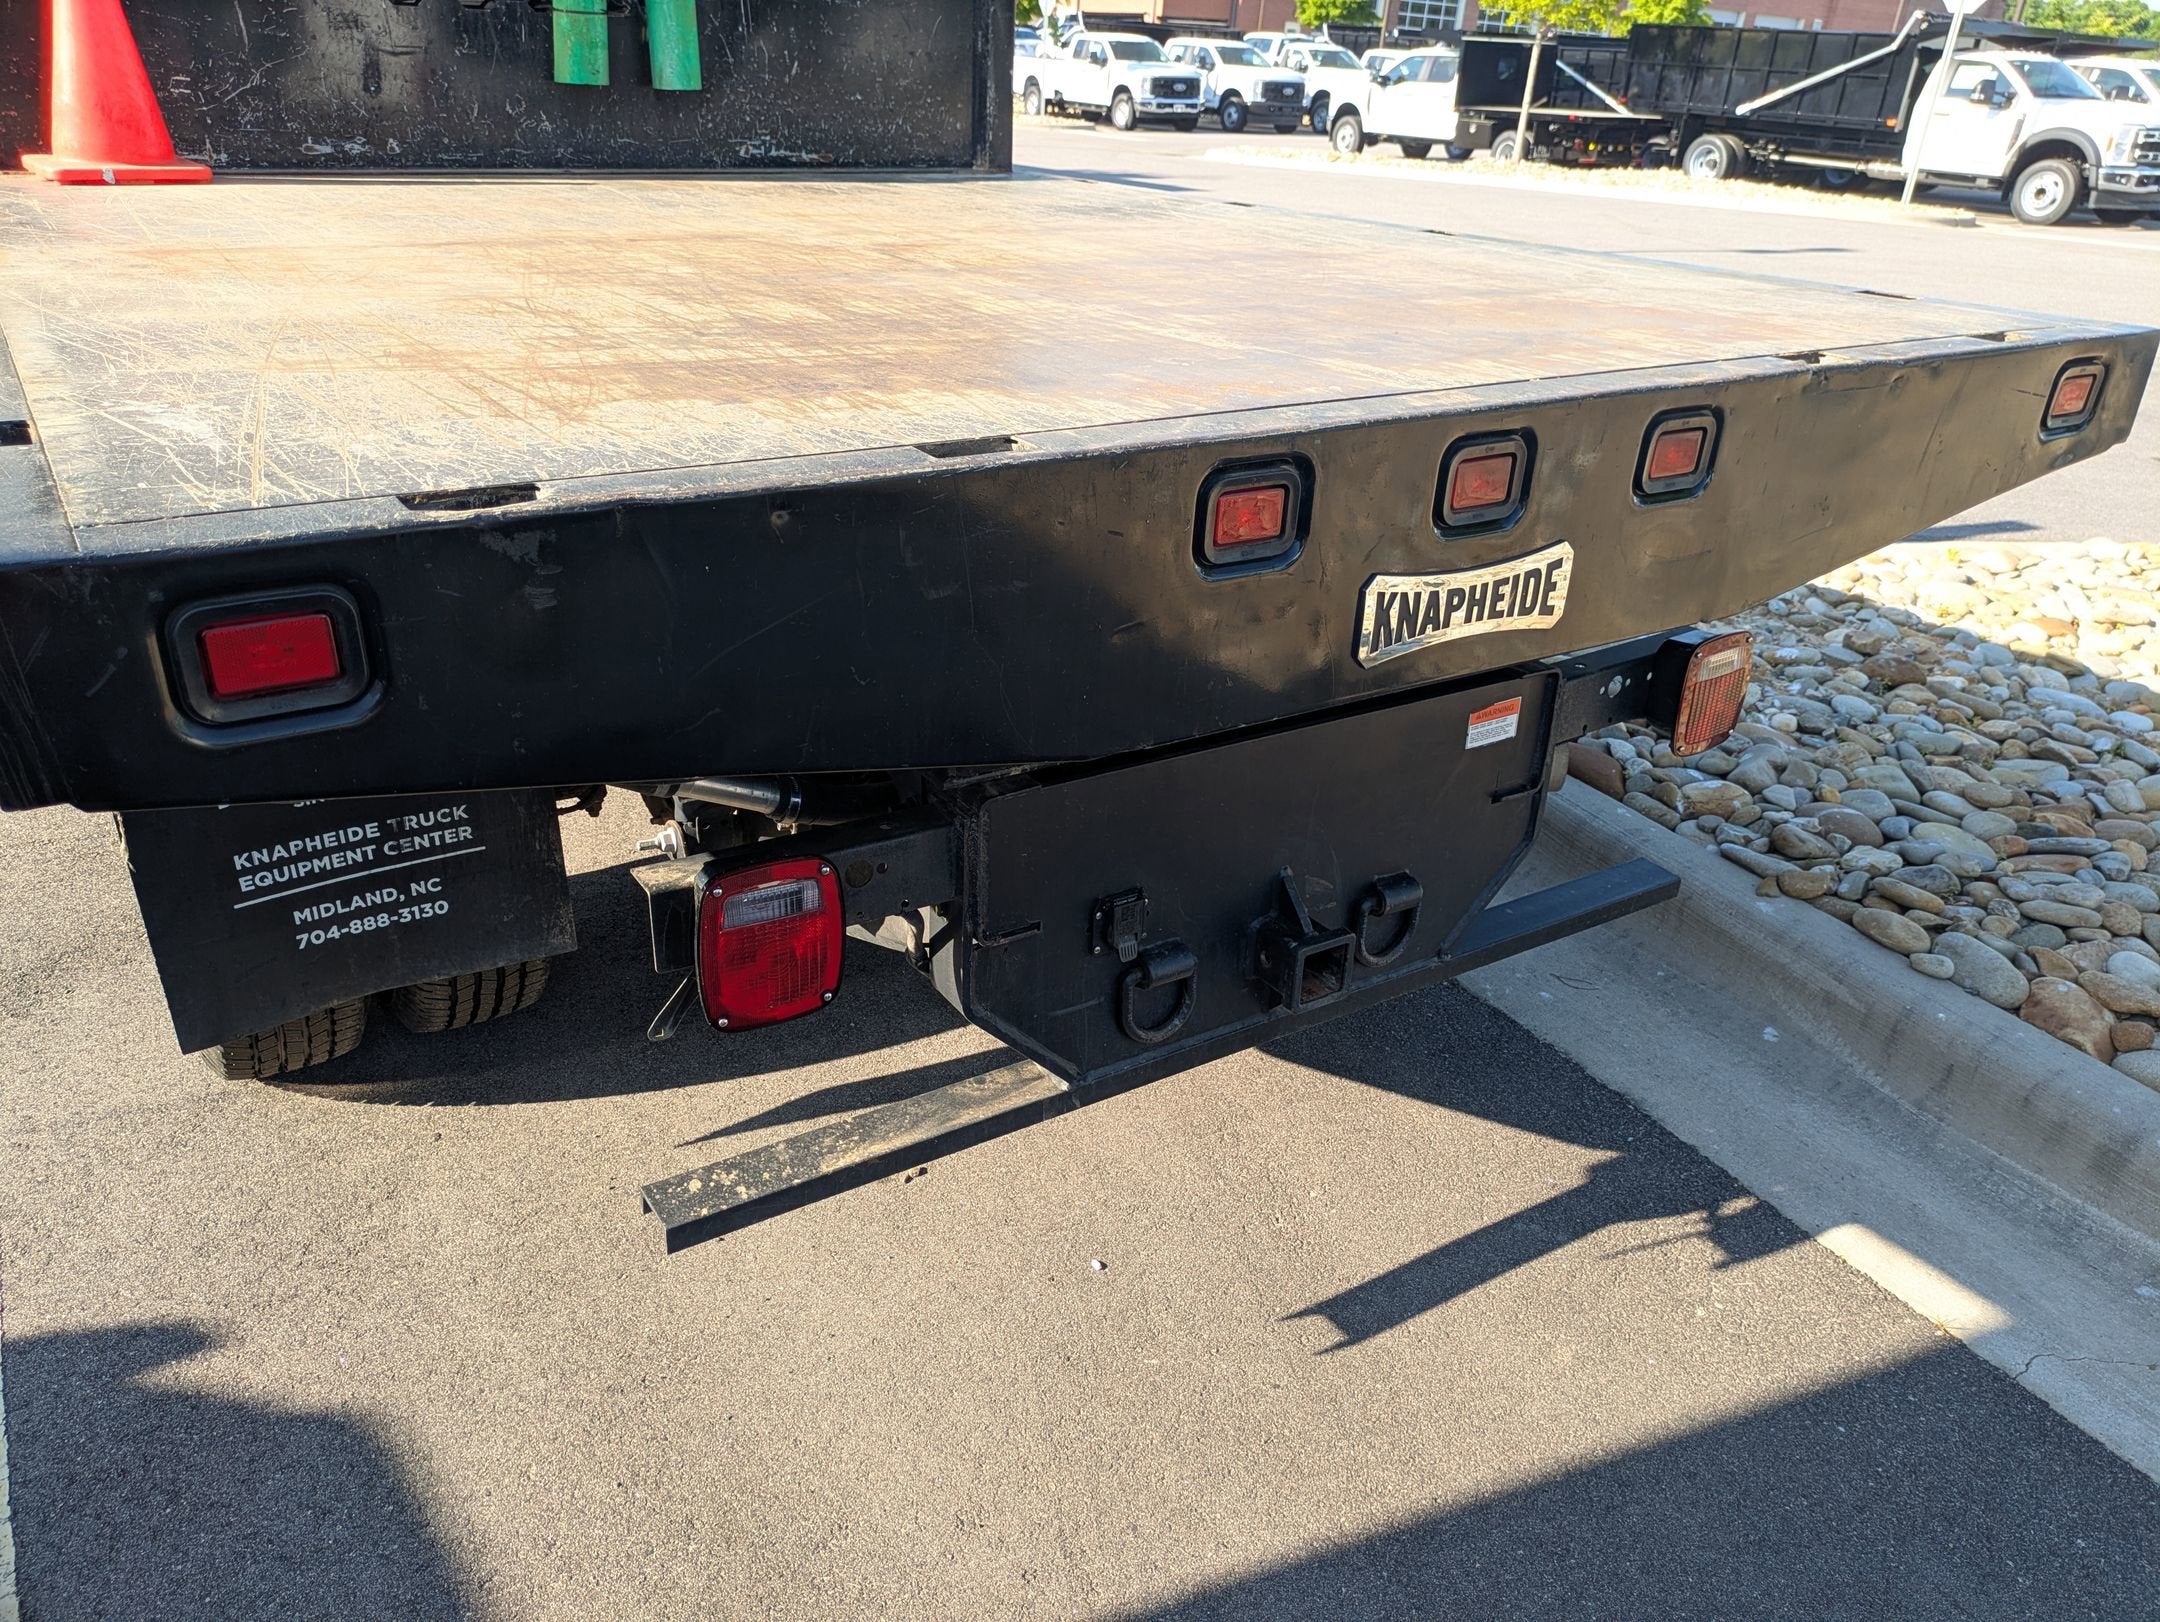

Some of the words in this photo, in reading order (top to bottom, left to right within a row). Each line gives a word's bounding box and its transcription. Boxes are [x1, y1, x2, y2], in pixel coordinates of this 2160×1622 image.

[1369, 557, 1563, 654] KNAPHEIDE
[1480, 703, 1515, 719] WARNING
[233, 822, 381, 870] KNAPHEIDE
[387, 804, 469, 832] TRUCK
[238, 845, 376, 892] EQUIPMENT
[384, 826, 473, 856] CENTER
[293, 887, 405, 925] MIDLAND,
[410, 877, 442, 897] NC
[296, 900, 449, 949] 704-888-3130
